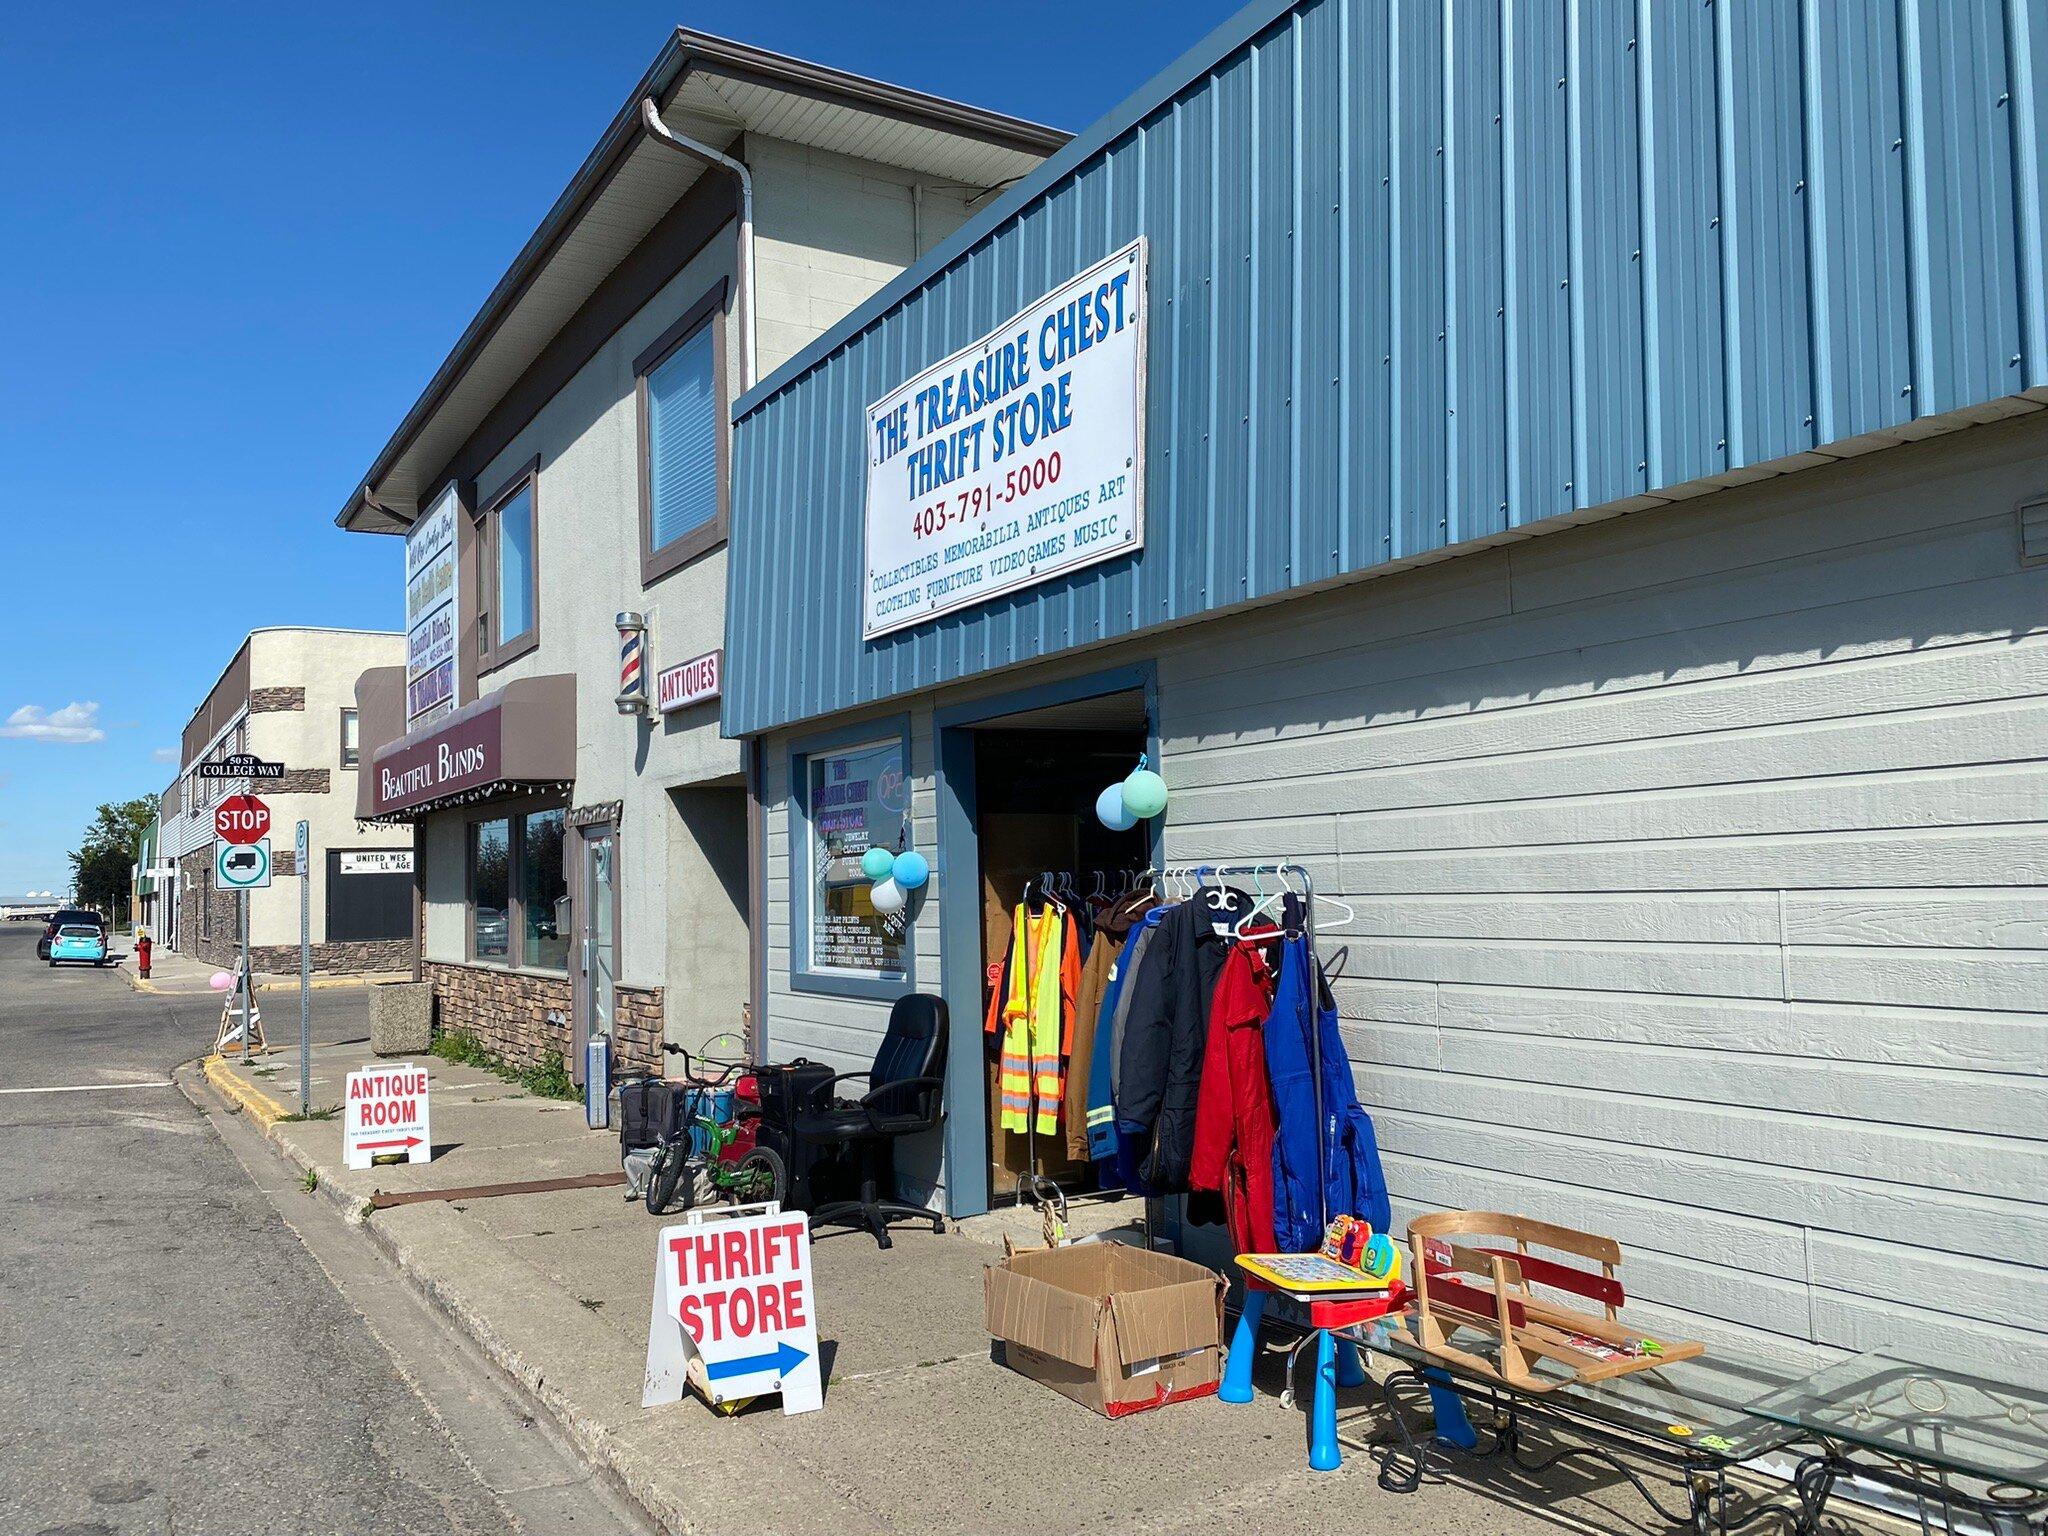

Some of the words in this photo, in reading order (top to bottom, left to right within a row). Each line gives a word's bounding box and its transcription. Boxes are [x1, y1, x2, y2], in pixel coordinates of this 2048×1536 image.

[876, 408, 908, 465] THE
[915, 330, 1030, 440] TREASURE
[1038, 270, 1131, 371] CHEST
[907, 421, 984, 501] THRIFT
[992, 372, 1073, 463] STORE
[913, 451, 1061, 540] 403-791-5000
[872, 553, 939, 594] COLLECTIBLES
[944, 521, 1020, 567] MEMORABILIA
[1028, 490, 1090, 531] ANTIQUES
[1099, 475, 1126, 505] ART
[875, 586, 921, 616] CLOTHING
[926, 565, 983, 600] FURNITURE
[1074, 515, 1118, 547] MUSIC
[661, 659, 715, 703] ANTIQUES
[203, 766, 256, 776] COLLEGE
[258, 766, 281, 776] WAY
[230, 757, 241, 765] 50
[217, 810, 268, 830] STOP
[356, 854, 385, 862] UNITED
[350, 1074, 426, 1099] ANTIQUE
[361, 1100, 417, 1126] ROOM
[669, 1222, 804, 1287] THRIFT
[679, 1279, 806, 1344] STORE
